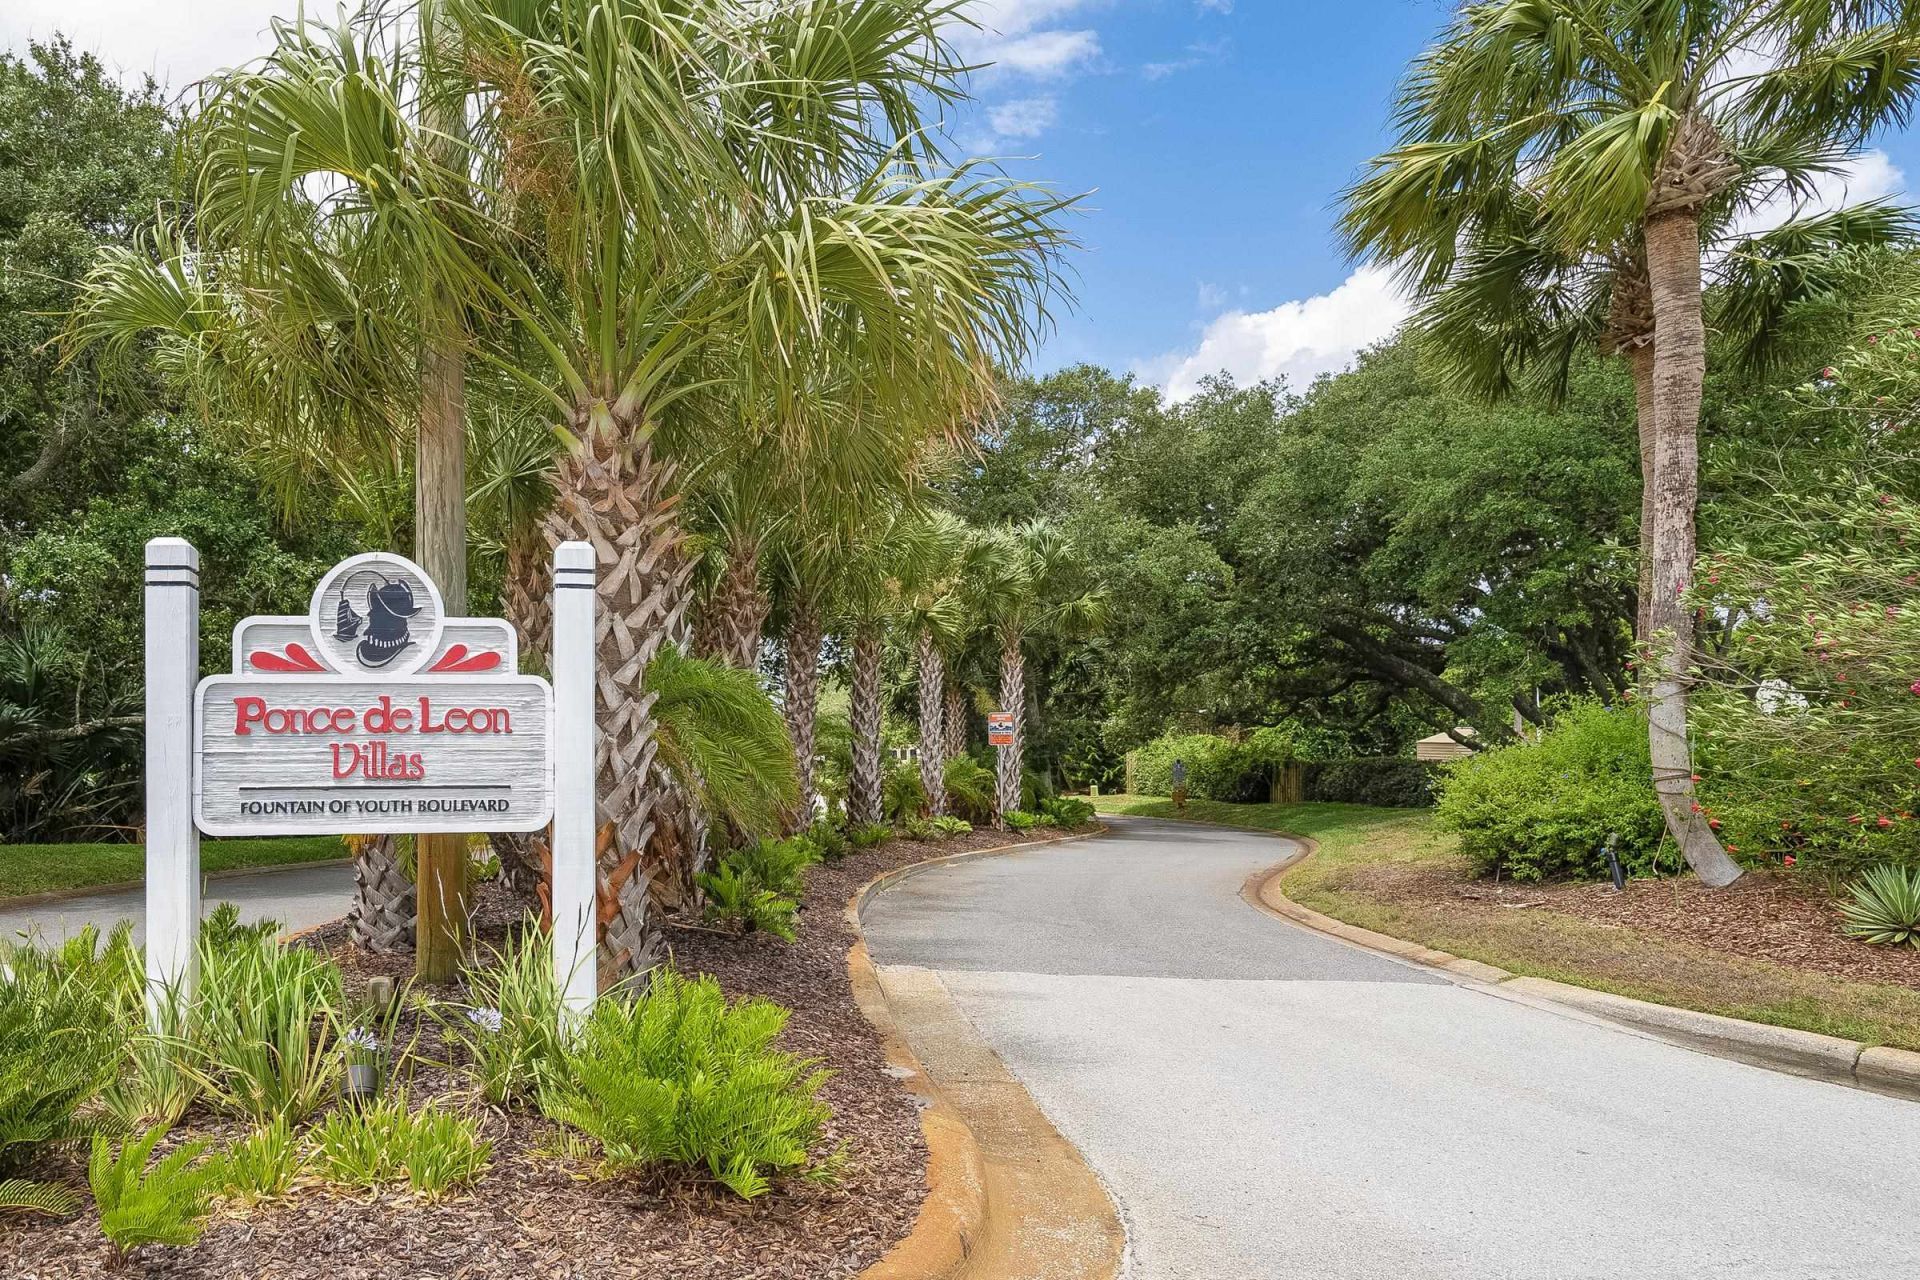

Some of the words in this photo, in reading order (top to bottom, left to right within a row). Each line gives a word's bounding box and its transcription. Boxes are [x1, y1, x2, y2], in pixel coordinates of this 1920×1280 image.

[234, 696, 356, 735] Ponce
[363, 696, 413, 734] de
[418, 696, 512, 734] Leon
[329, 741, 425, 780] Villas
[240, 801, 325, 814] FOUNTAIN
[328, 800, 352, 813] OF
[355, 800, 413, 813] YOUTH
[417, 799, 510, 813] BOULEVARD
